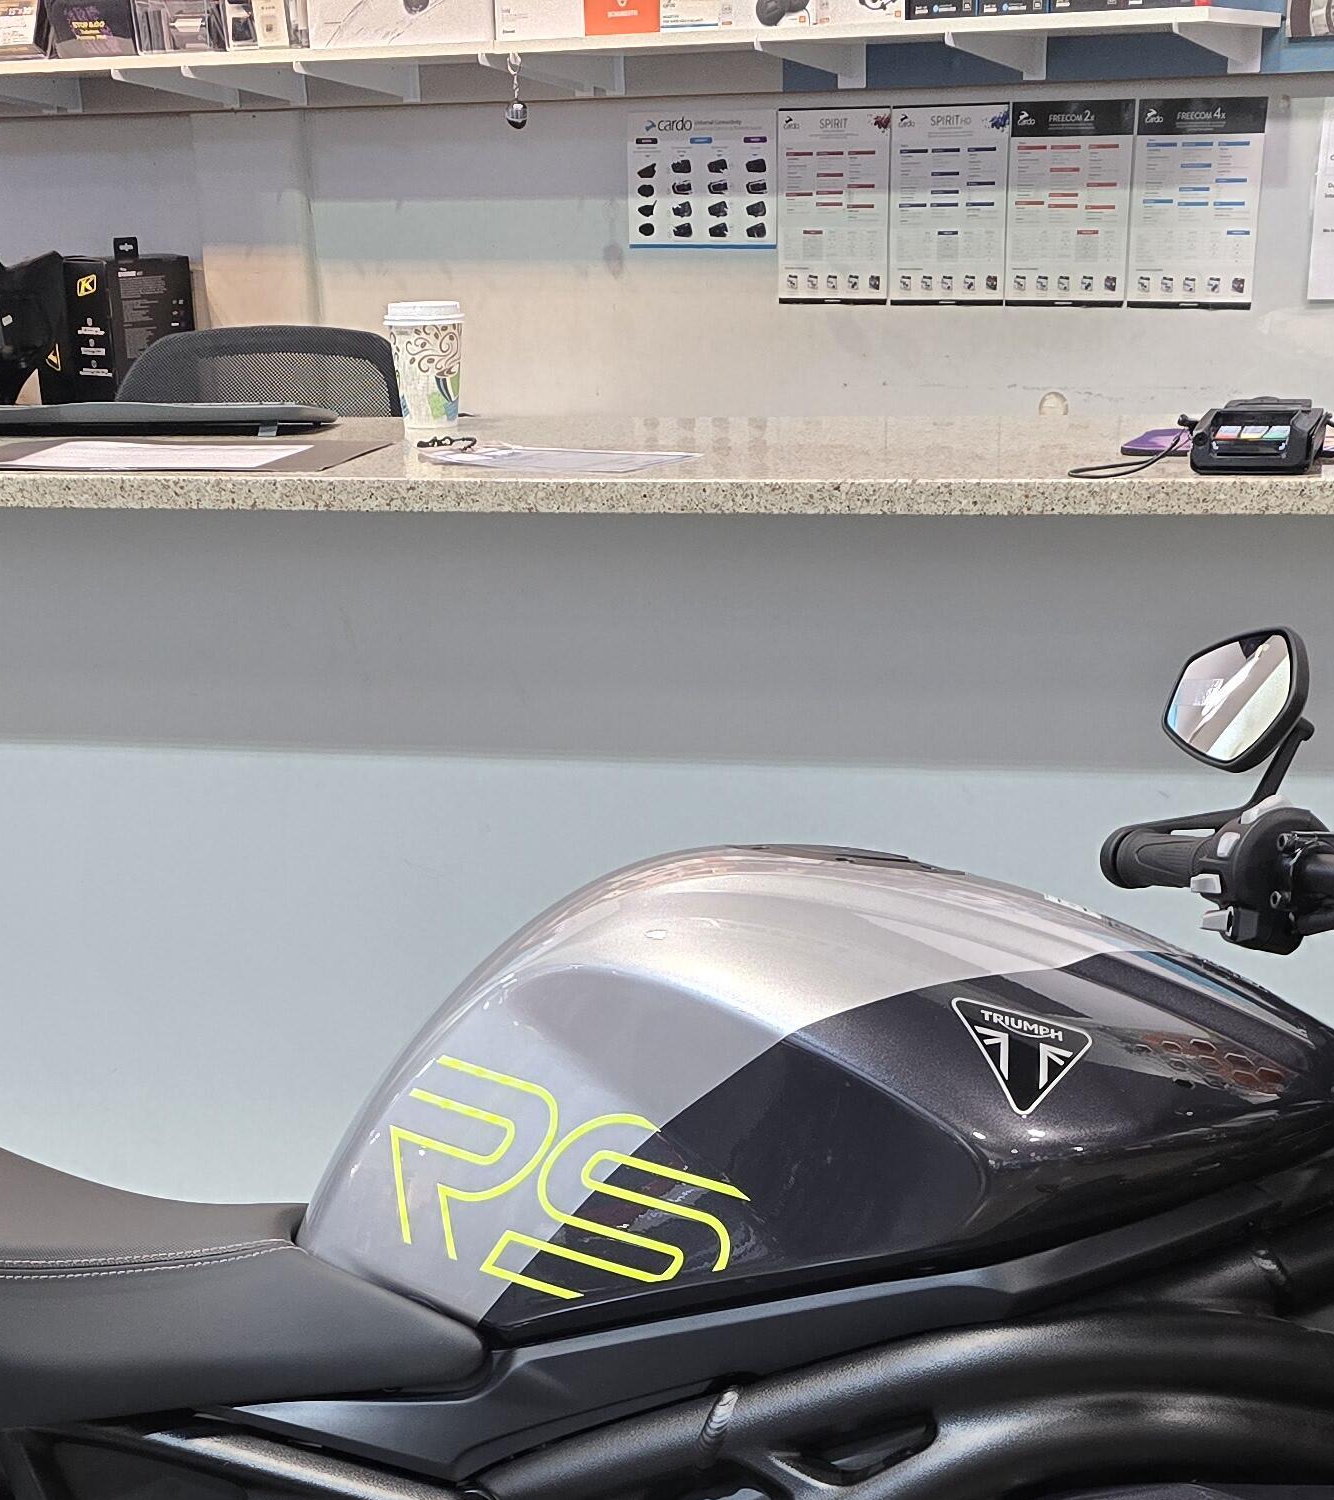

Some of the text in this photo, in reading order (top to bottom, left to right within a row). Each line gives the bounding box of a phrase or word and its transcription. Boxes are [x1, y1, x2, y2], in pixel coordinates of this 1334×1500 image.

[931, 115, 960, 126] SPIRIT
[1049, 113, 1083, 123] FREECOM
[1177, 107, 1226, 121] FREECOM 4x
[657, 117, 692, 132] cardo
[819, 117, 848, 129] SPIRIT
[981, 1010, 1063, 1041] TRIUMPH
[388, 1055, 751, 1299] RS
